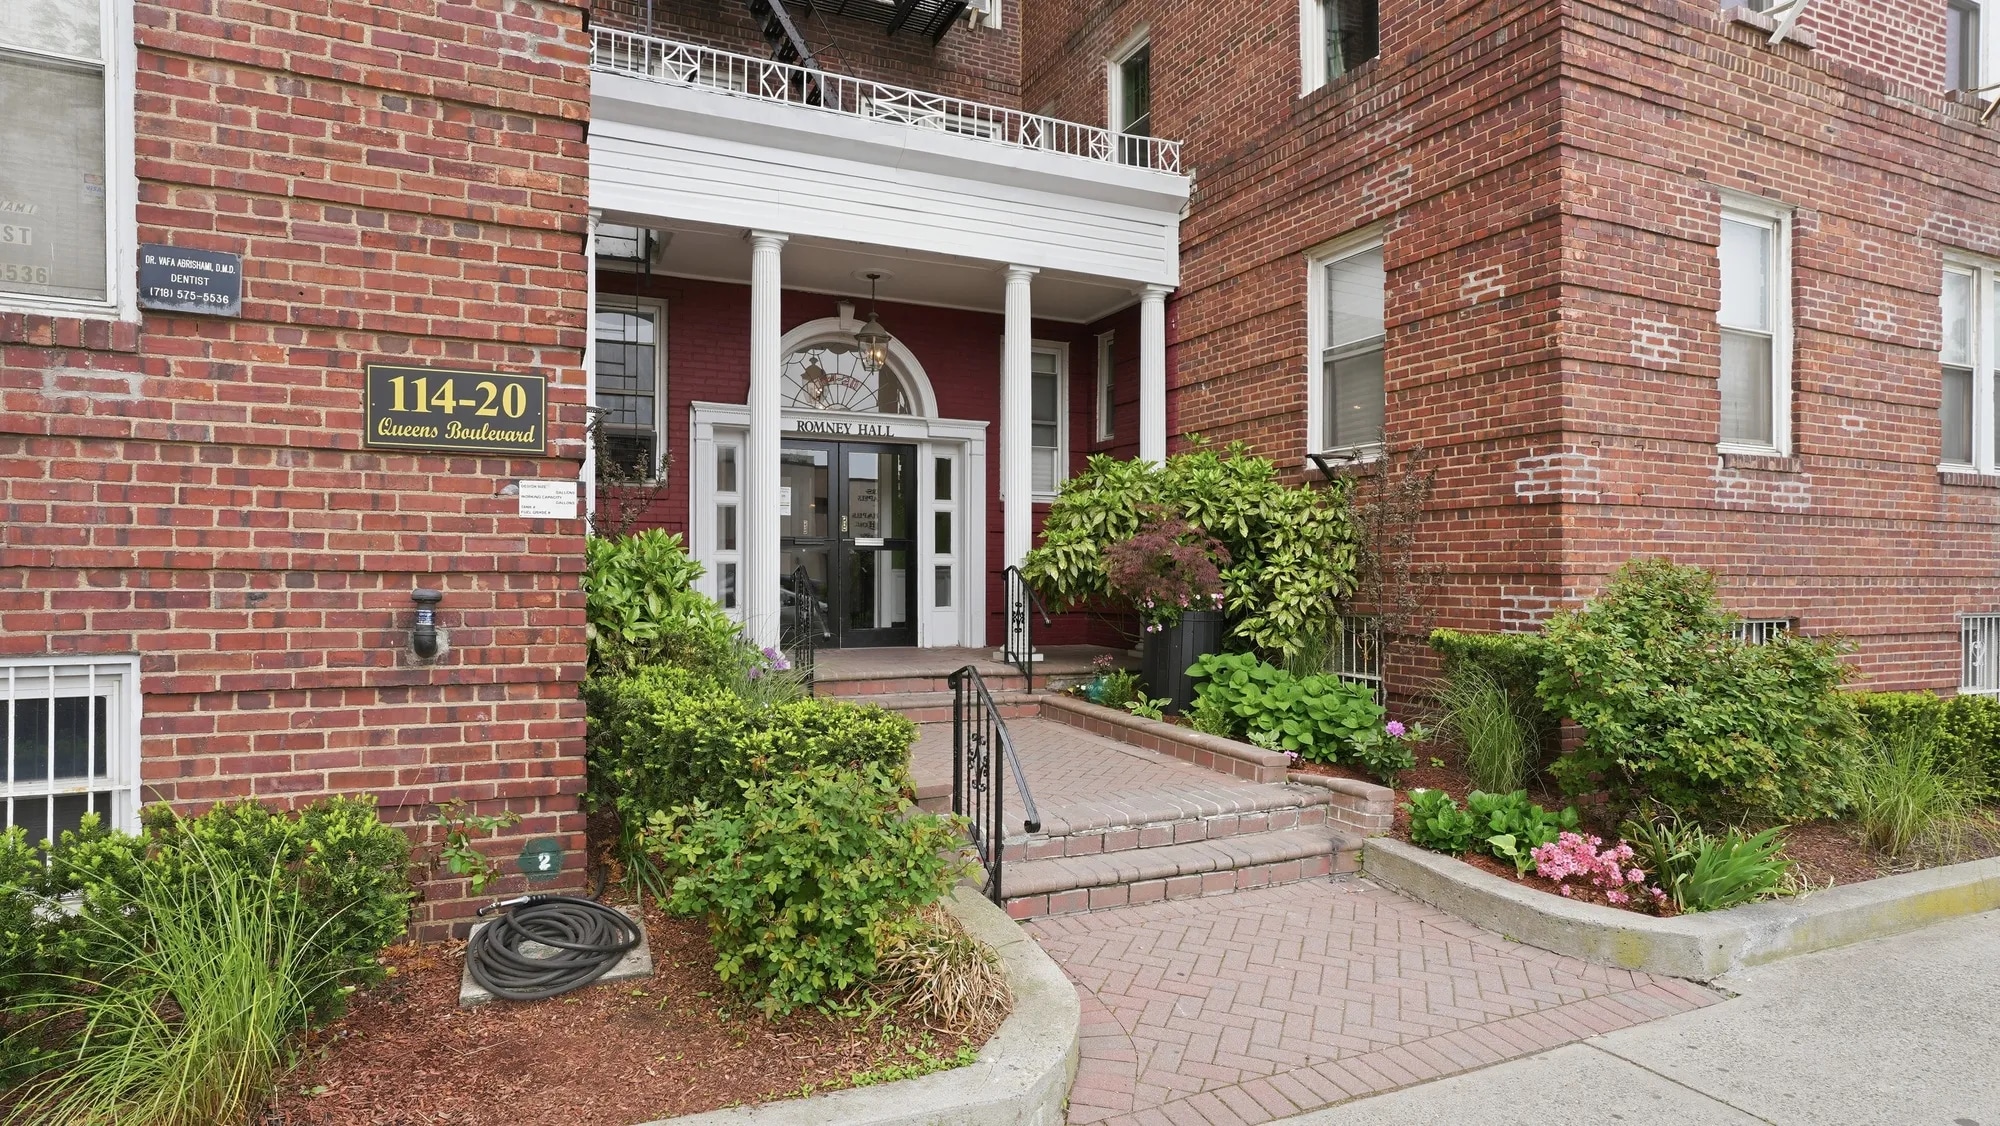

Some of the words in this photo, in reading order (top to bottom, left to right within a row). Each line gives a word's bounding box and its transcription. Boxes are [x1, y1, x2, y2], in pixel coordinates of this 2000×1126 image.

[0, 201, 35, 214] AMI
[145, 255, 157, 265] DR.
[158, 256, 176, 267] VAFA
[215, 263, 236, 275] D.M.D.
[0, 264, 47, 284] 536
[170, 273, 210, 286] DENTIST
[149, 287, 174, 298] (718)
[176, 290, 230, 304] 575-5536
[387, 375, 527, 419] 114-20
[377, 416, 439, 439] Queens
[444, 420, 536, 444] Boulevard
[796, 420, 852, 435] ROMNEY
[858, 424, 895, 437] HALL
[538, 853, 551, 870] 2
